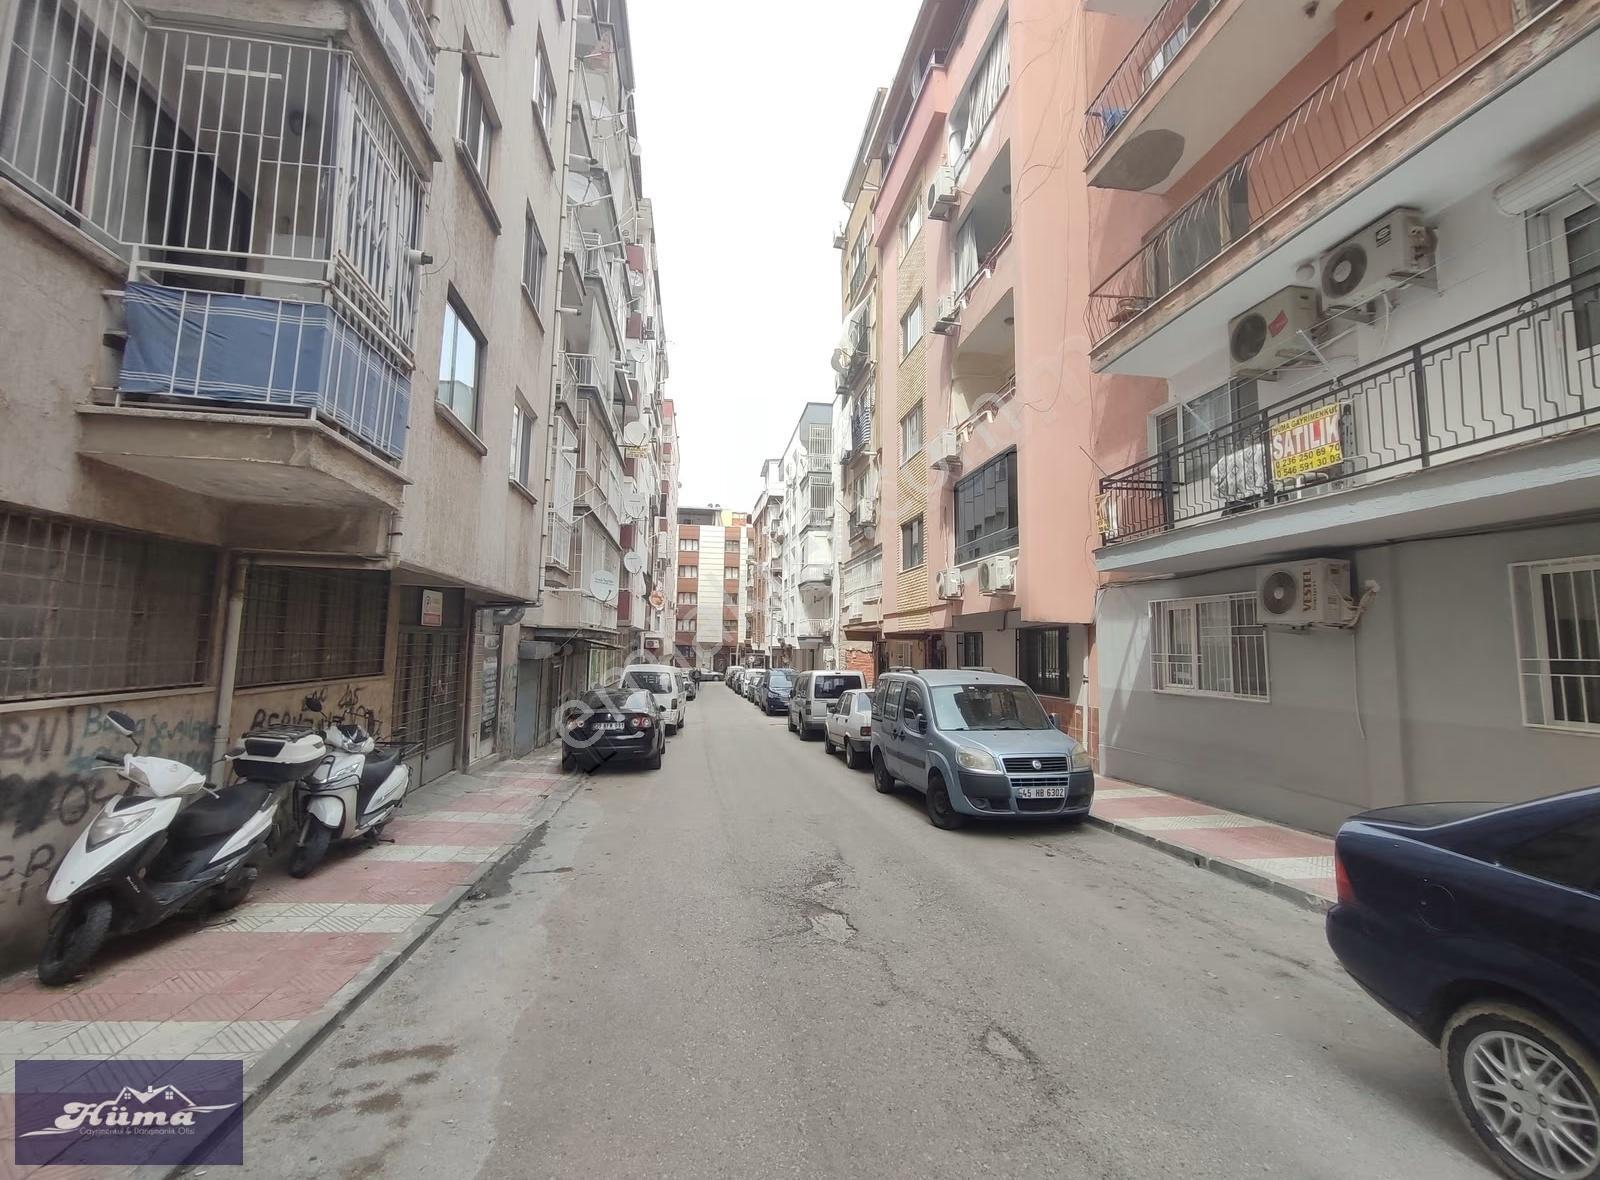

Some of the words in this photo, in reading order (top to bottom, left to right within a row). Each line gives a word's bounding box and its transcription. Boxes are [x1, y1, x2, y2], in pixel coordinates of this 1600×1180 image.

[1272, 414, 1340, 460] SATILIK
[1283, 466, 1298, 477] 546
[1299, 461, 1314, 472] 591
[1302, 568, 1313, 612] VESTEL
[1022, 788, 1032, 798] 45
[1035, 788, 1045, 798] HB
[1046, 788, 1064, 797] 6302
